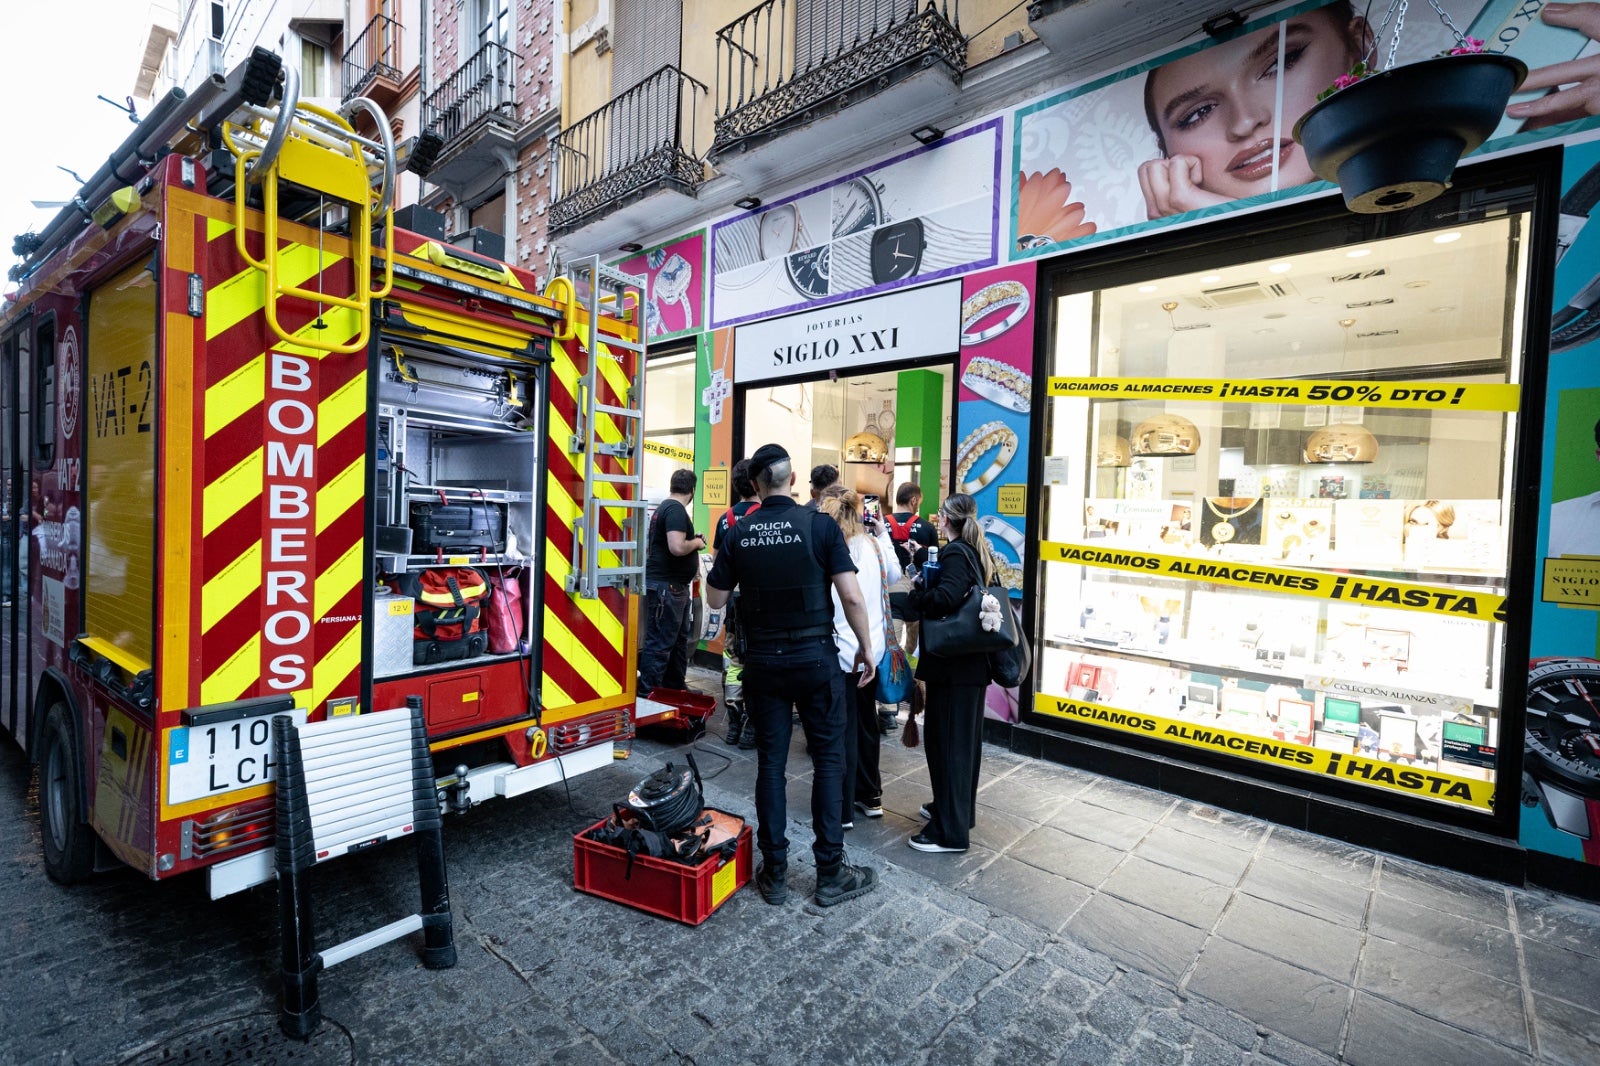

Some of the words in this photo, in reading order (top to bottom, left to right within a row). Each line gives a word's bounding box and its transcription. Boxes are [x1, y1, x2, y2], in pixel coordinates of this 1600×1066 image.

[806, 313, 863, 333] JOYERIAS
[773, 338, 840, 366] SIGLO
[848, 327, 900, 355] XXI
[91, 360, 151, 438] VAT-2
[1053, 382, 1119, 392] VACIAMOS
[1123, 384, 1213, 394] ALMACENES
[1307, 385, 1382, 402] 50%
[659, 447, 677, 457] 50%
[264, 353, 315, 690] BOMBEROS
[749, 521, 792, 531] POLICIA
[740, 534, 802, 547] GRANADA
[1059, 548, 1161, 570] VACIAMOS
[1168, 561, 1319, 591] ALMACENES
[1552, 576, 1599, 585] SIGLO
[1561, 588, 1589, 597] XXI
[321, 616, 357, 624] PERSIANA
[1333, 683, 1388, 696] COLECCIÓN
[1390, 691, 1437, 704] ALIANZAS
[206, 719, 270, 755] 110
[1056, 701, 1157, 731] VACIAMOS
[1164, 724, 1314, 765] ALMACENES
[175, 749, 184, 759] E
